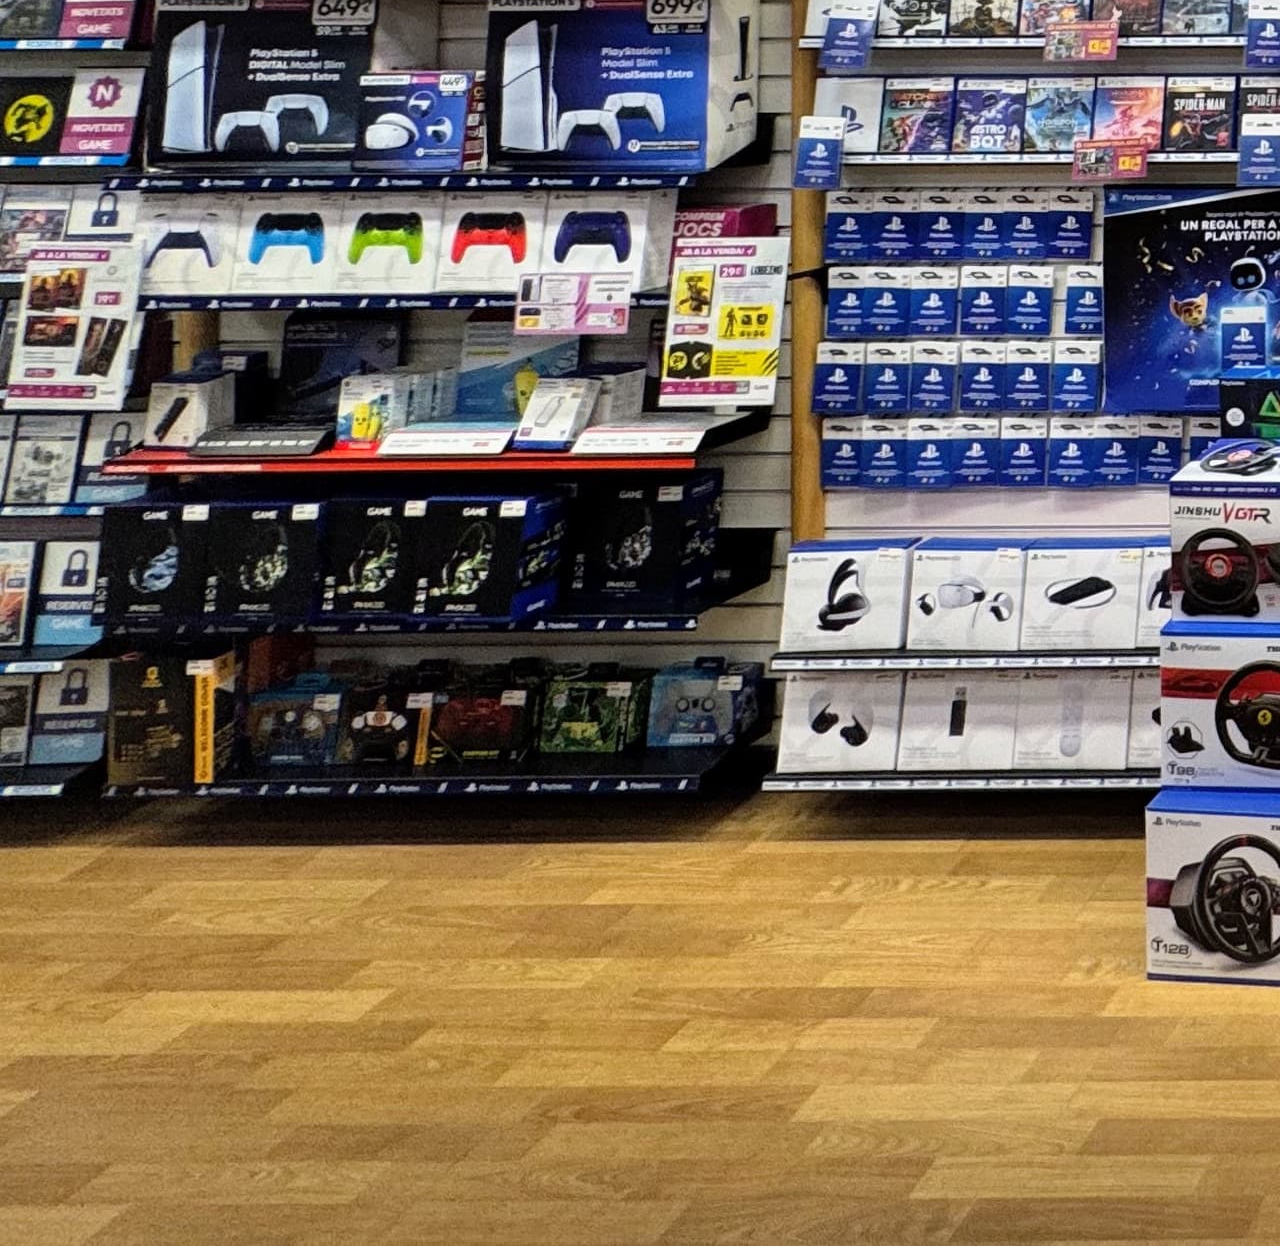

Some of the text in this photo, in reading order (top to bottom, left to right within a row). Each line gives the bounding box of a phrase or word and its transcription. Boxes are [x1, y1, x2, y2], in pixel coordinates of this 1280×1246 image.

[77, 24, 112, 34] GAME
[249, 60, 345, 70] DIGITAL Model Slim
[602, 58, 658, 67] Model Slim
[609, 69, 665, 80] DualSense
[667, 69, 693, 80] Extra
[1174, 98, 1226, 111] SPIDER-MAN
[971, 124, 1006, 135] ASTRO
[971, 135, 1005, 149] BOT
[673, 222, 723, 237] JOCS
[1180, 220, 1199, 231] UN
[1202, 220, 1238, 231] REGAL
[1243, 219, 1265, 230] PER
[1267, 219, 1277, 229] A
[1174, 506, 1221, 517] JINSHU
